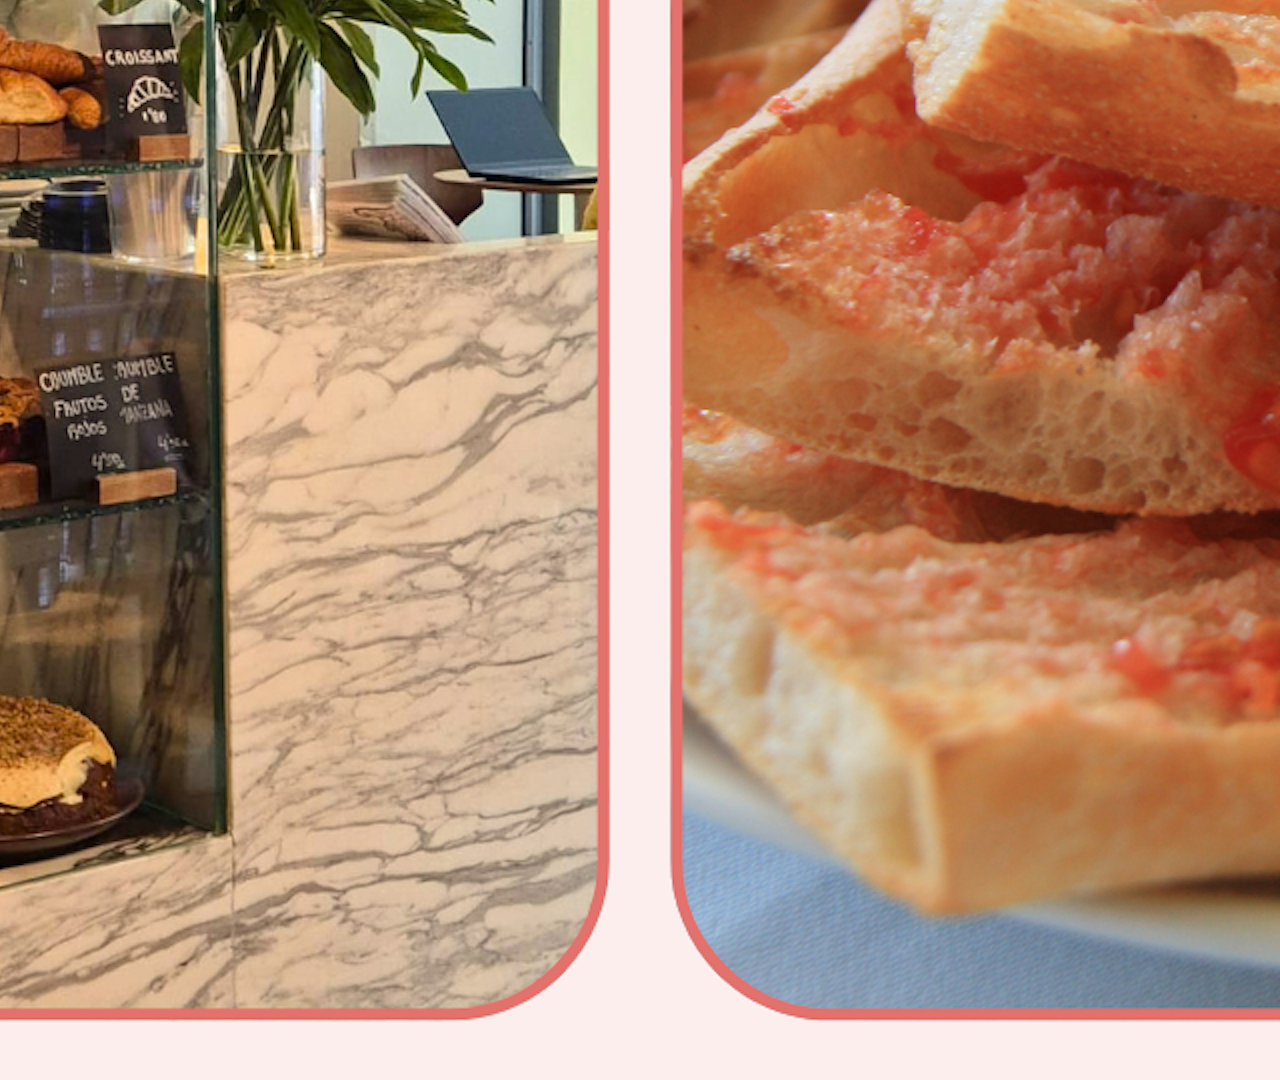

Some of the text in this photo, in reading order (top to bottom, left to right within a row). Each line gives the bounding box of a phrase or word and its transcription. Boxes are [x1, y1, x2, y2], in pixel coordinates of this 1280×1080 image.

[105, 48, 179, 67] CROISSANT
[38, 363, 105, 393] CRUMBLE
[121, 383, 140, 403] DE
[53, 395, 109, 419] FRUTOS
[67, 421, 108, 441] ROJOS
